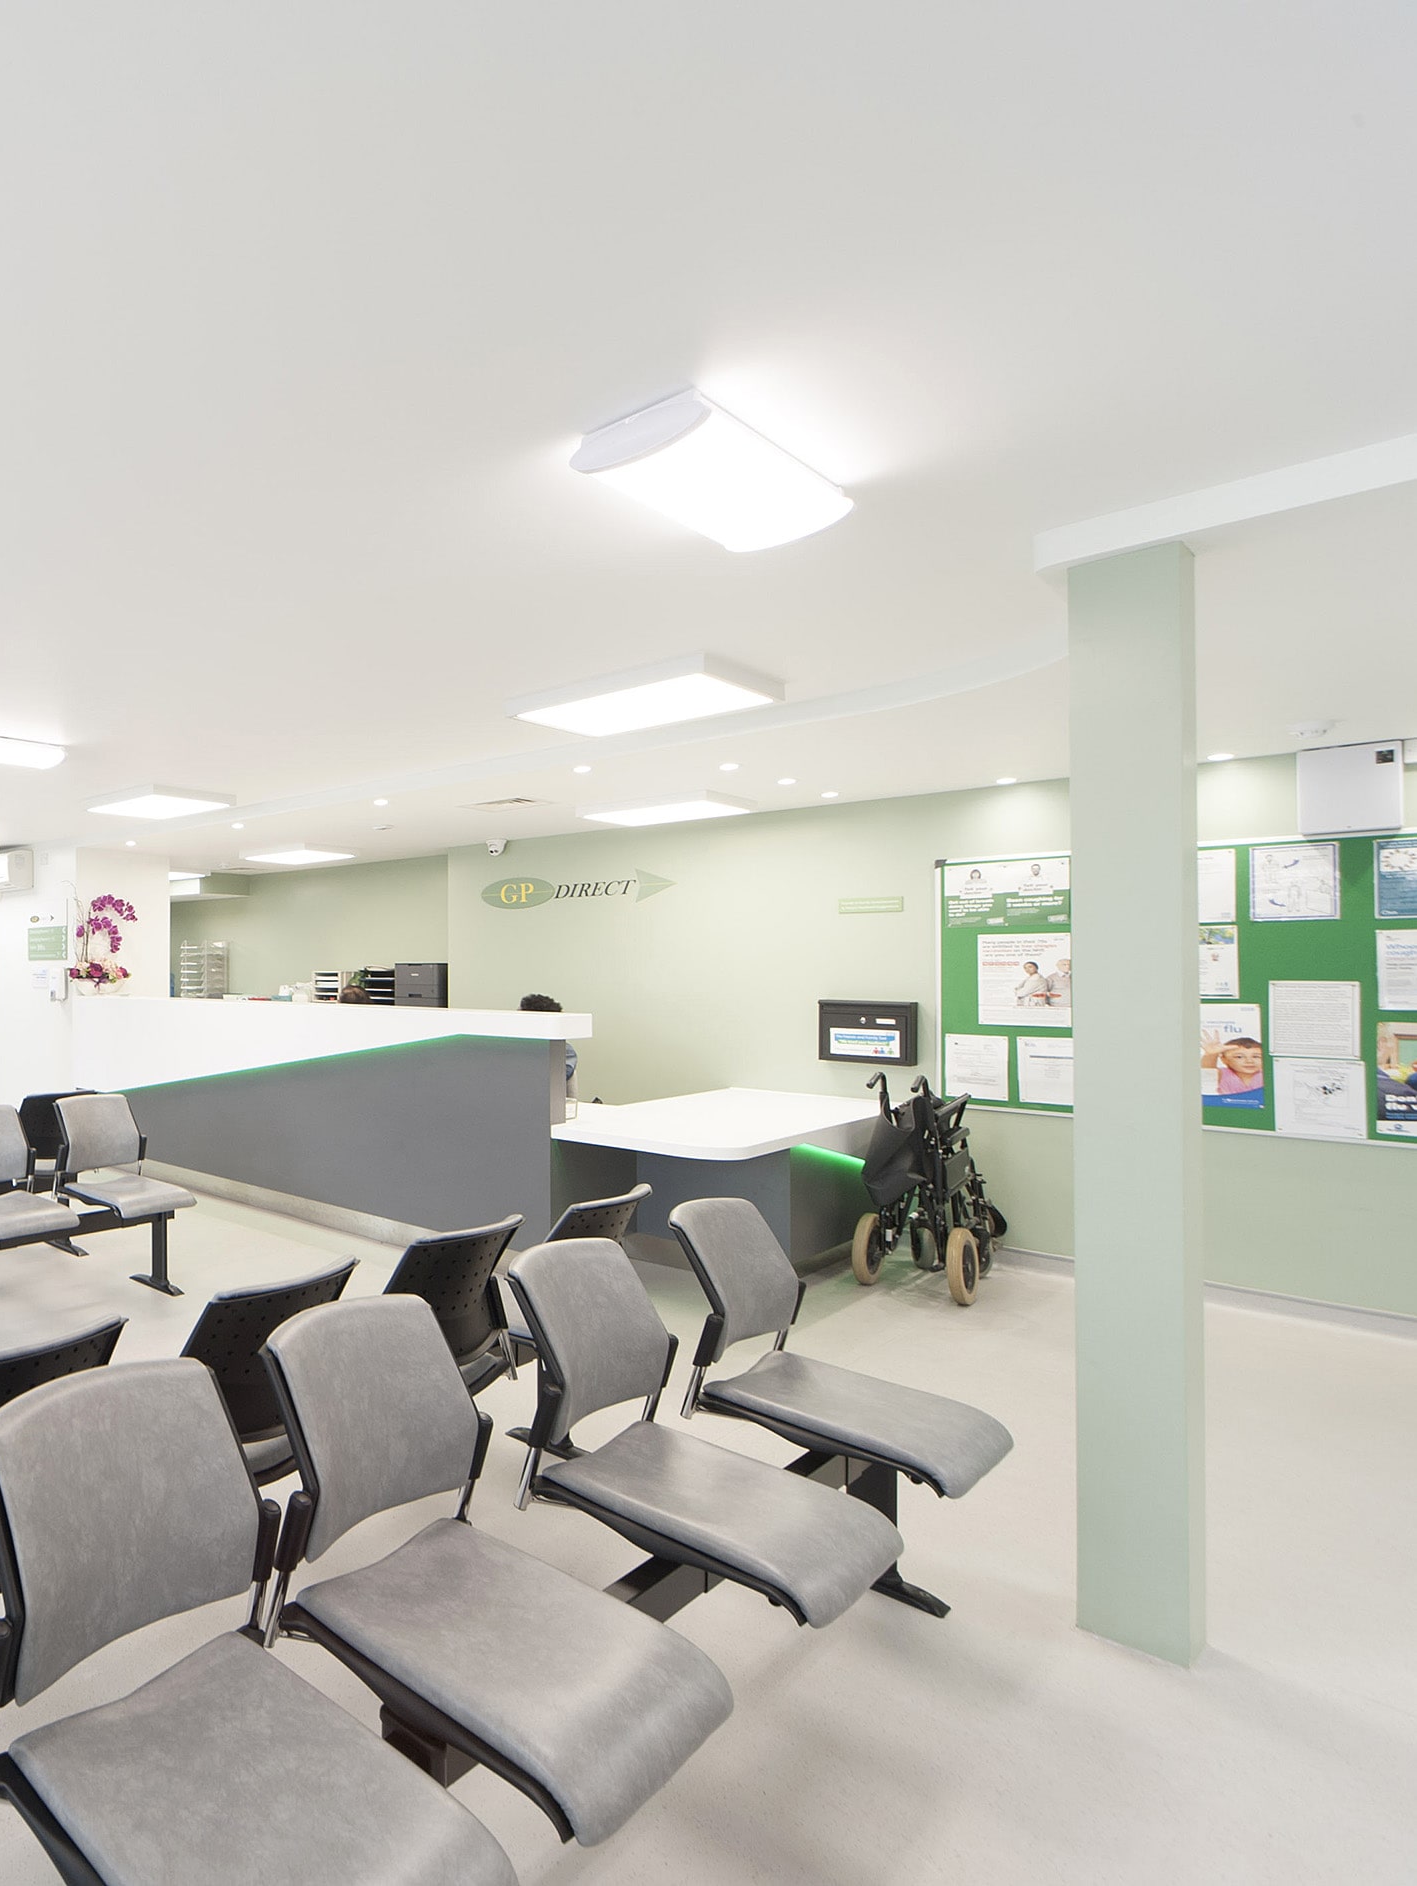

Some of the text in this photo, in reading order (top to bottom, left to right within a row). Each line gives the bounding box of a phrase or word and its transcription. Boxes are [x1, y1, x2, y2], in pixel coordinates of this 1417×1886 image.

[500, 879, 636, 904] GP DIRECT
[1223, 1024, 1242, 1033] flu
